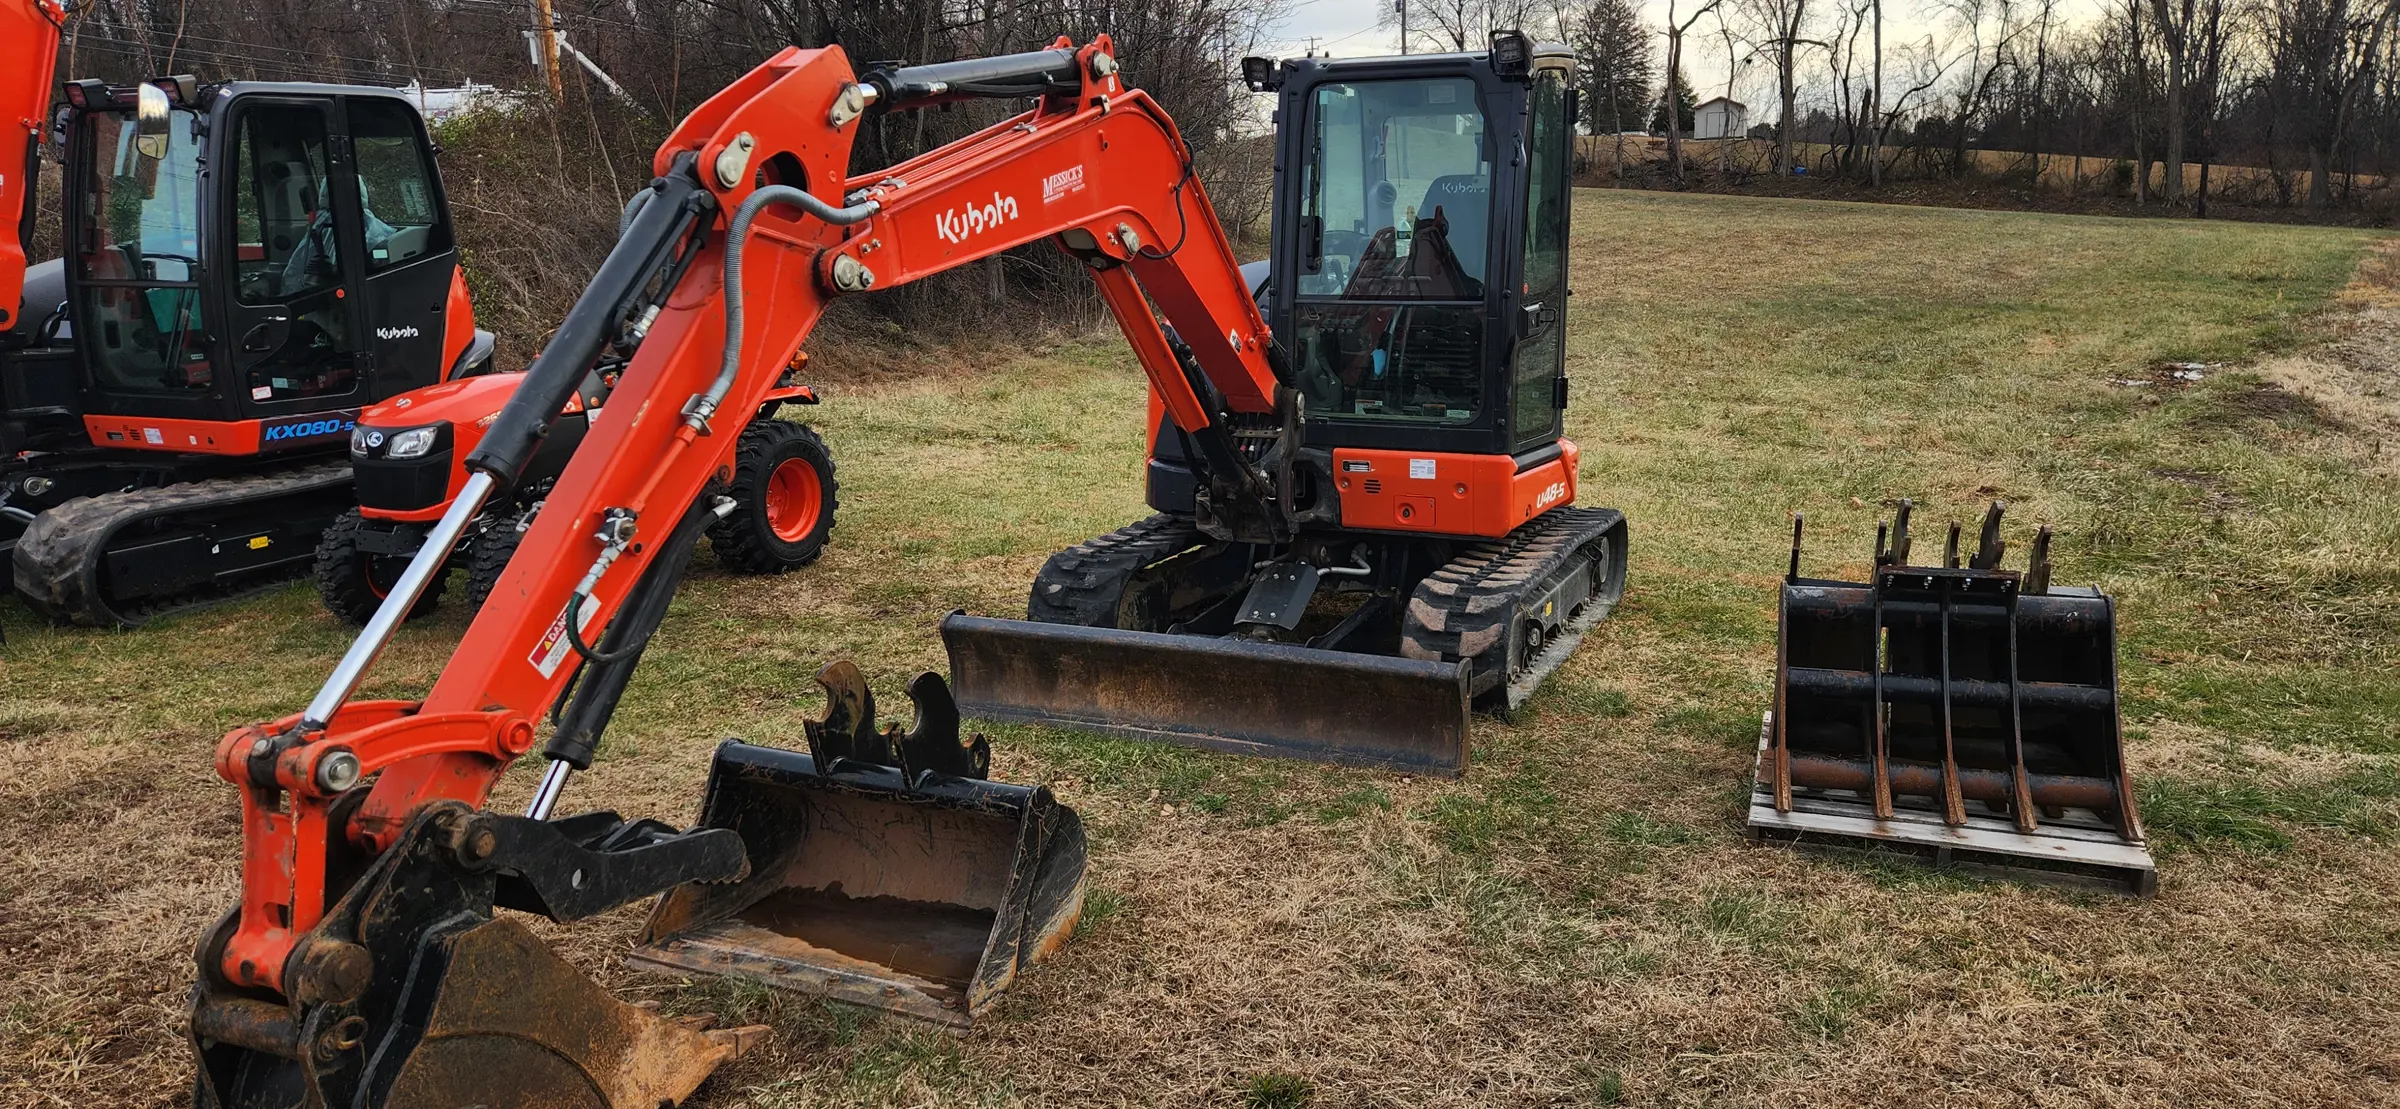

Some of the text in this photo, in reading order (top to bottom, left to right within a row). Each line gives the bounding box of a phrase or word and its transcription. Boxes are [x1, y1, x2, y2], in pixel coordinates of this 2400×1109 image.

[1043, 164, 1083, 198] MESSICK'S
[936, 191, 1018, 244] Kubota
[377, 325, 419, 339] Kubota
[265, 420, 355, 440] KX080-5
[1536, 482, 1565, 508] U48-5
